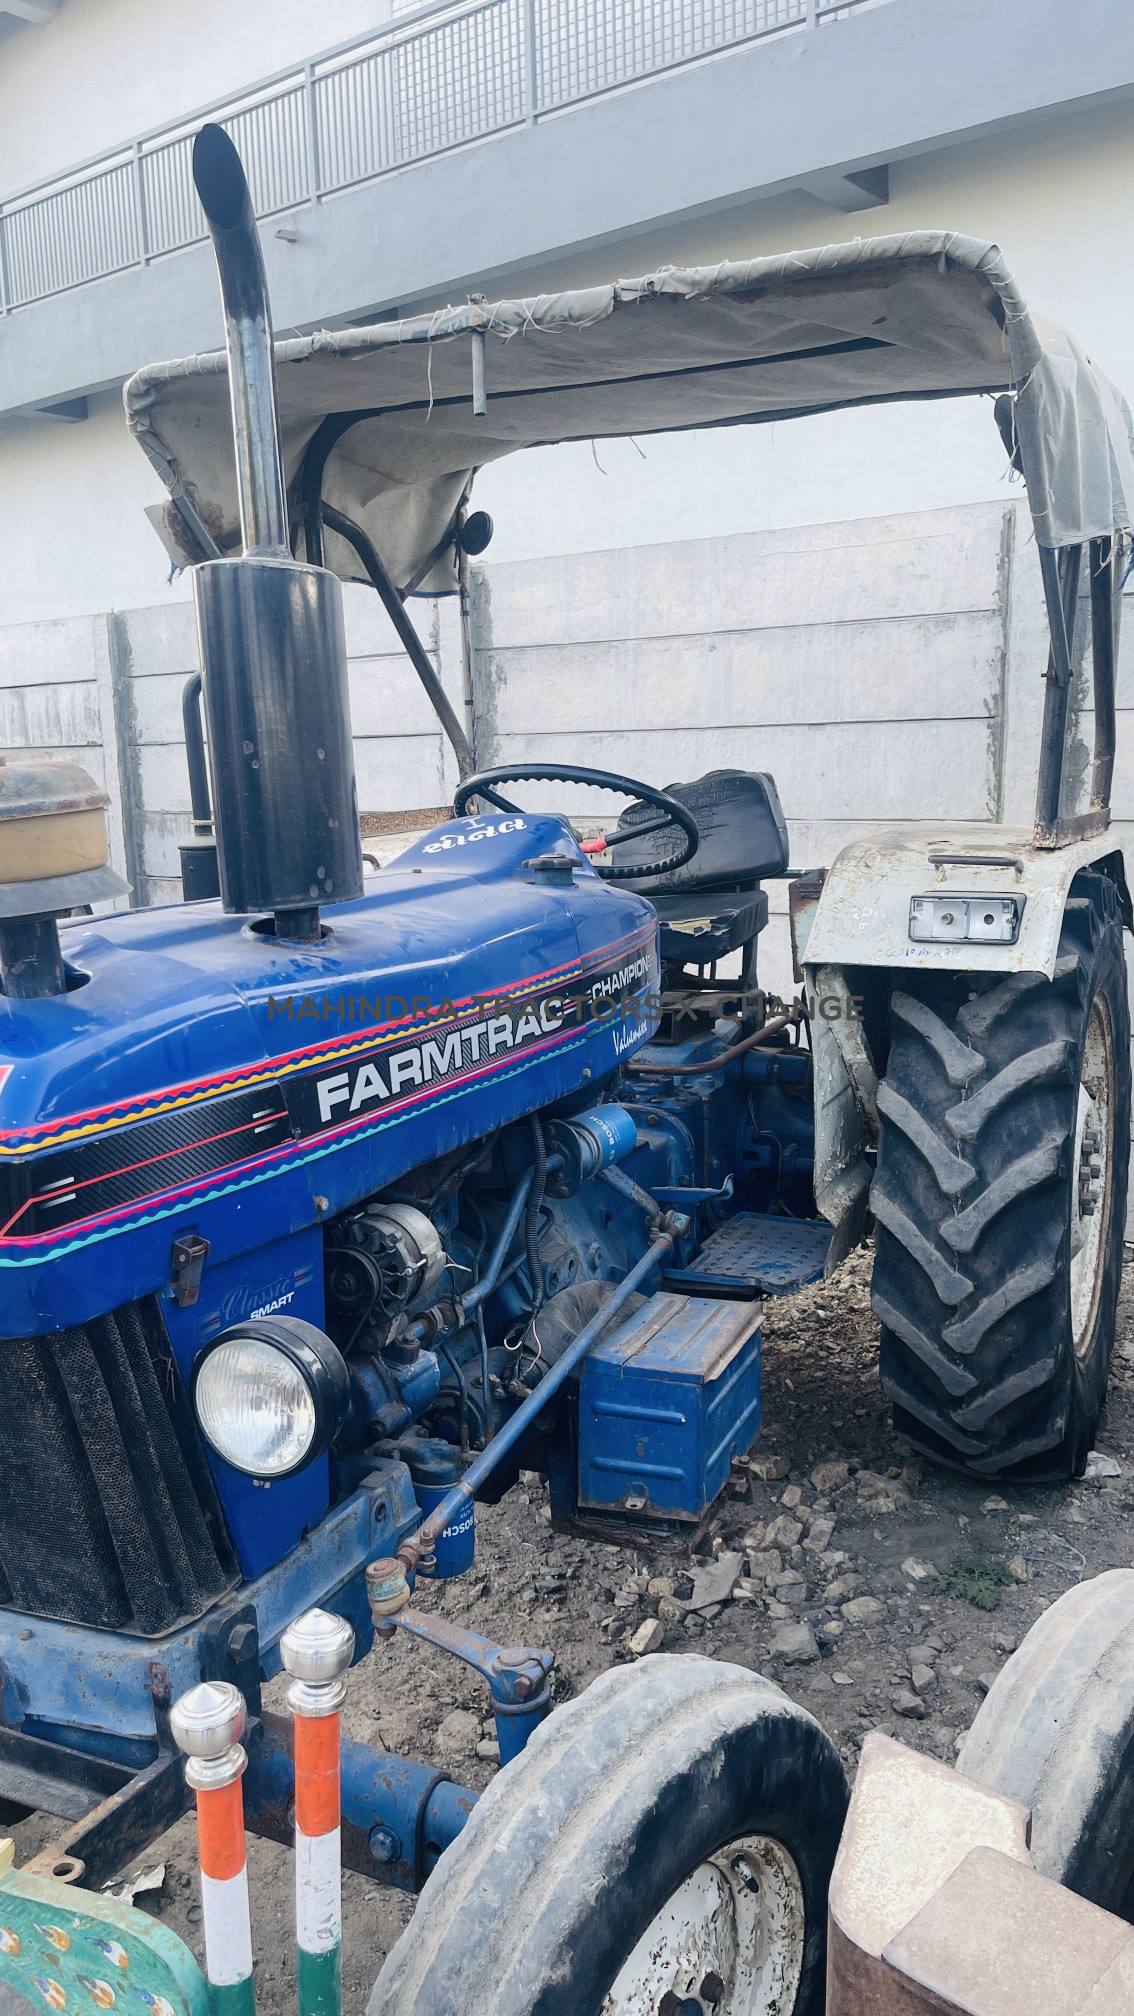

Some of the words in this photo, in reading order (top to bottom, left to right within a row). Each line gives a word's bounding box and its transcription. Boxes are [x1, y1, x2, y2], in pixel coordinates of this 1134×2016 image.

[592, 955, 649, 1000] CHAMPION
[316, 996, 563, 1123] FARMTRAC
[590, 1116, 615, 1145] BOSCH
[221, 1276, 293, 1320] Classic
[250, 1291, 294, 1320] SMART
